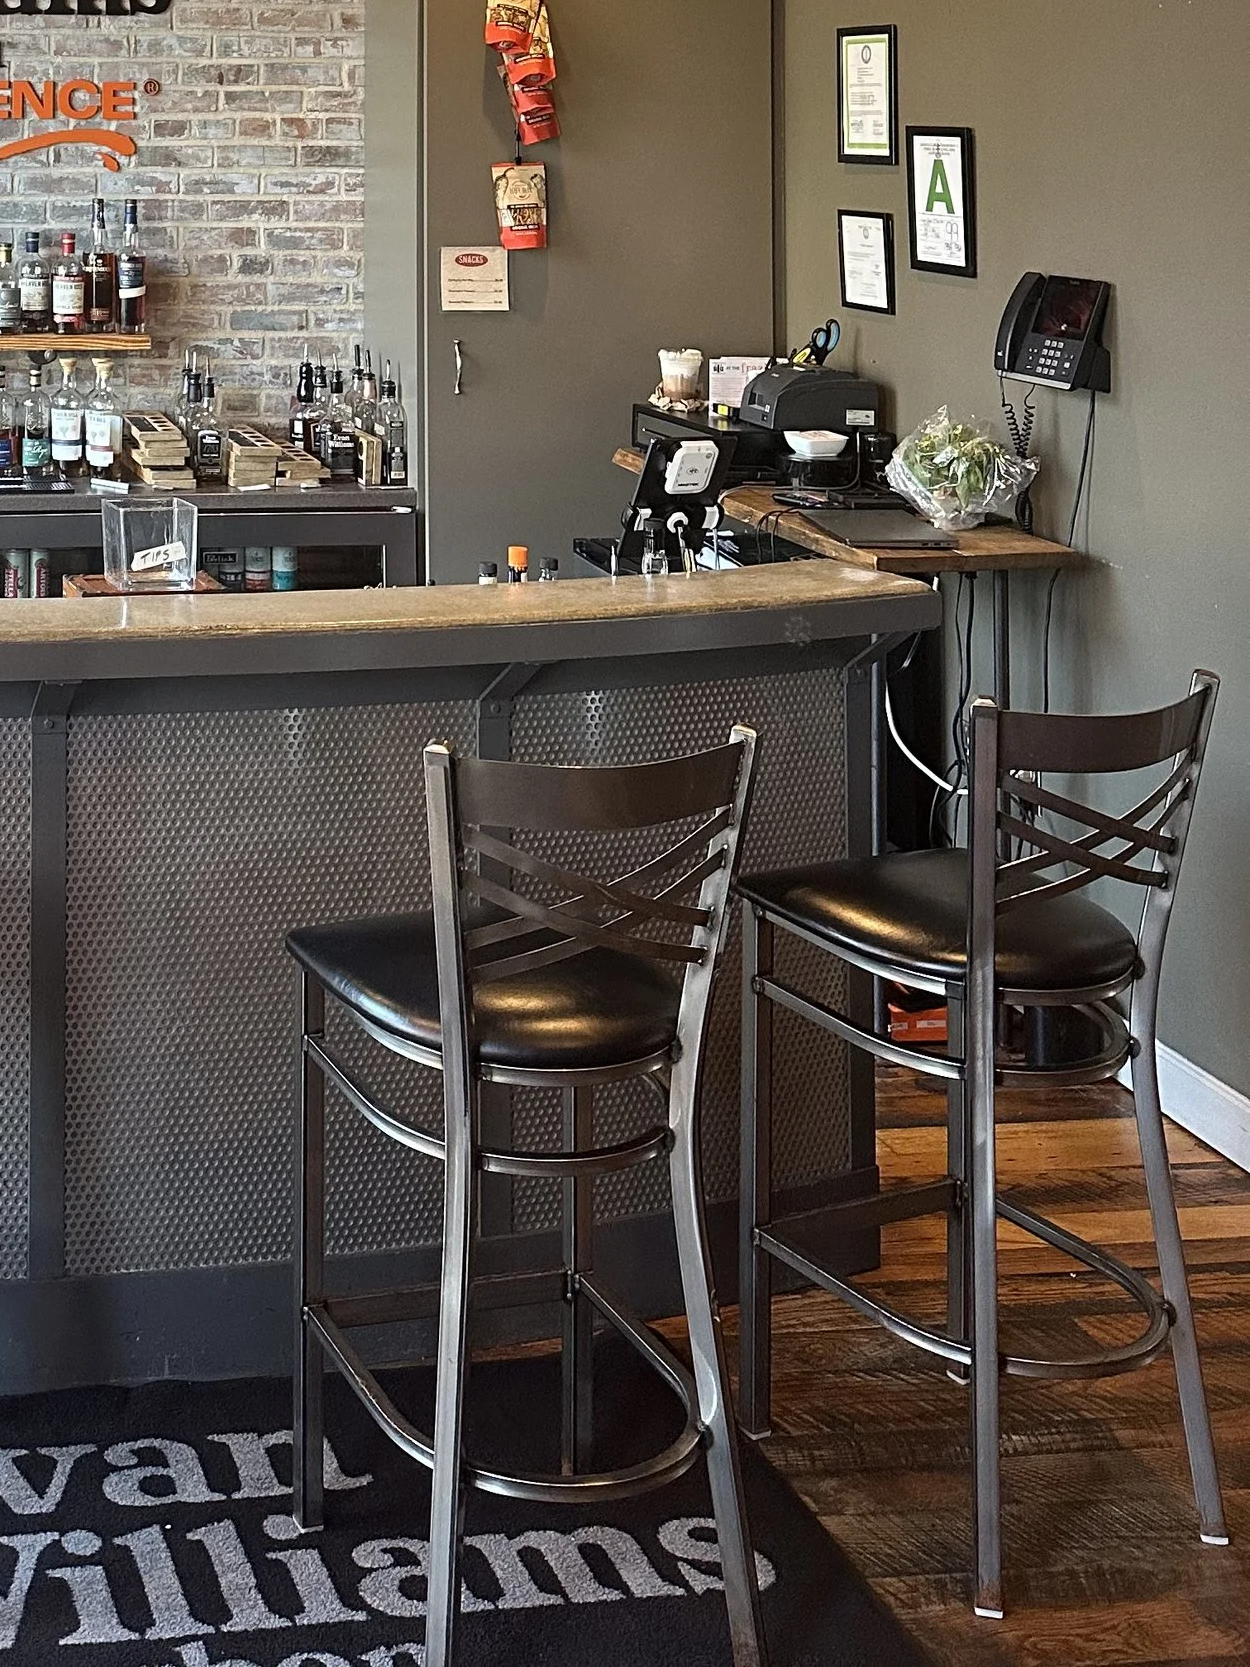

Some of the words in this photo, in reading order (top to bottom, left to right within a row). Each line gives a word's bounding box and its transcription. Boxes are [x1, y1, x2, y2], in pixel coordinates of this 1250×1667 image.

[925, 159, 955, 215] A
[458, 255, 484, 264] SNACKS
[332, 433, 350, 442] Evan
[329, 439, 355, 448] Williams
[140, 548, 171, 565] TIPS
